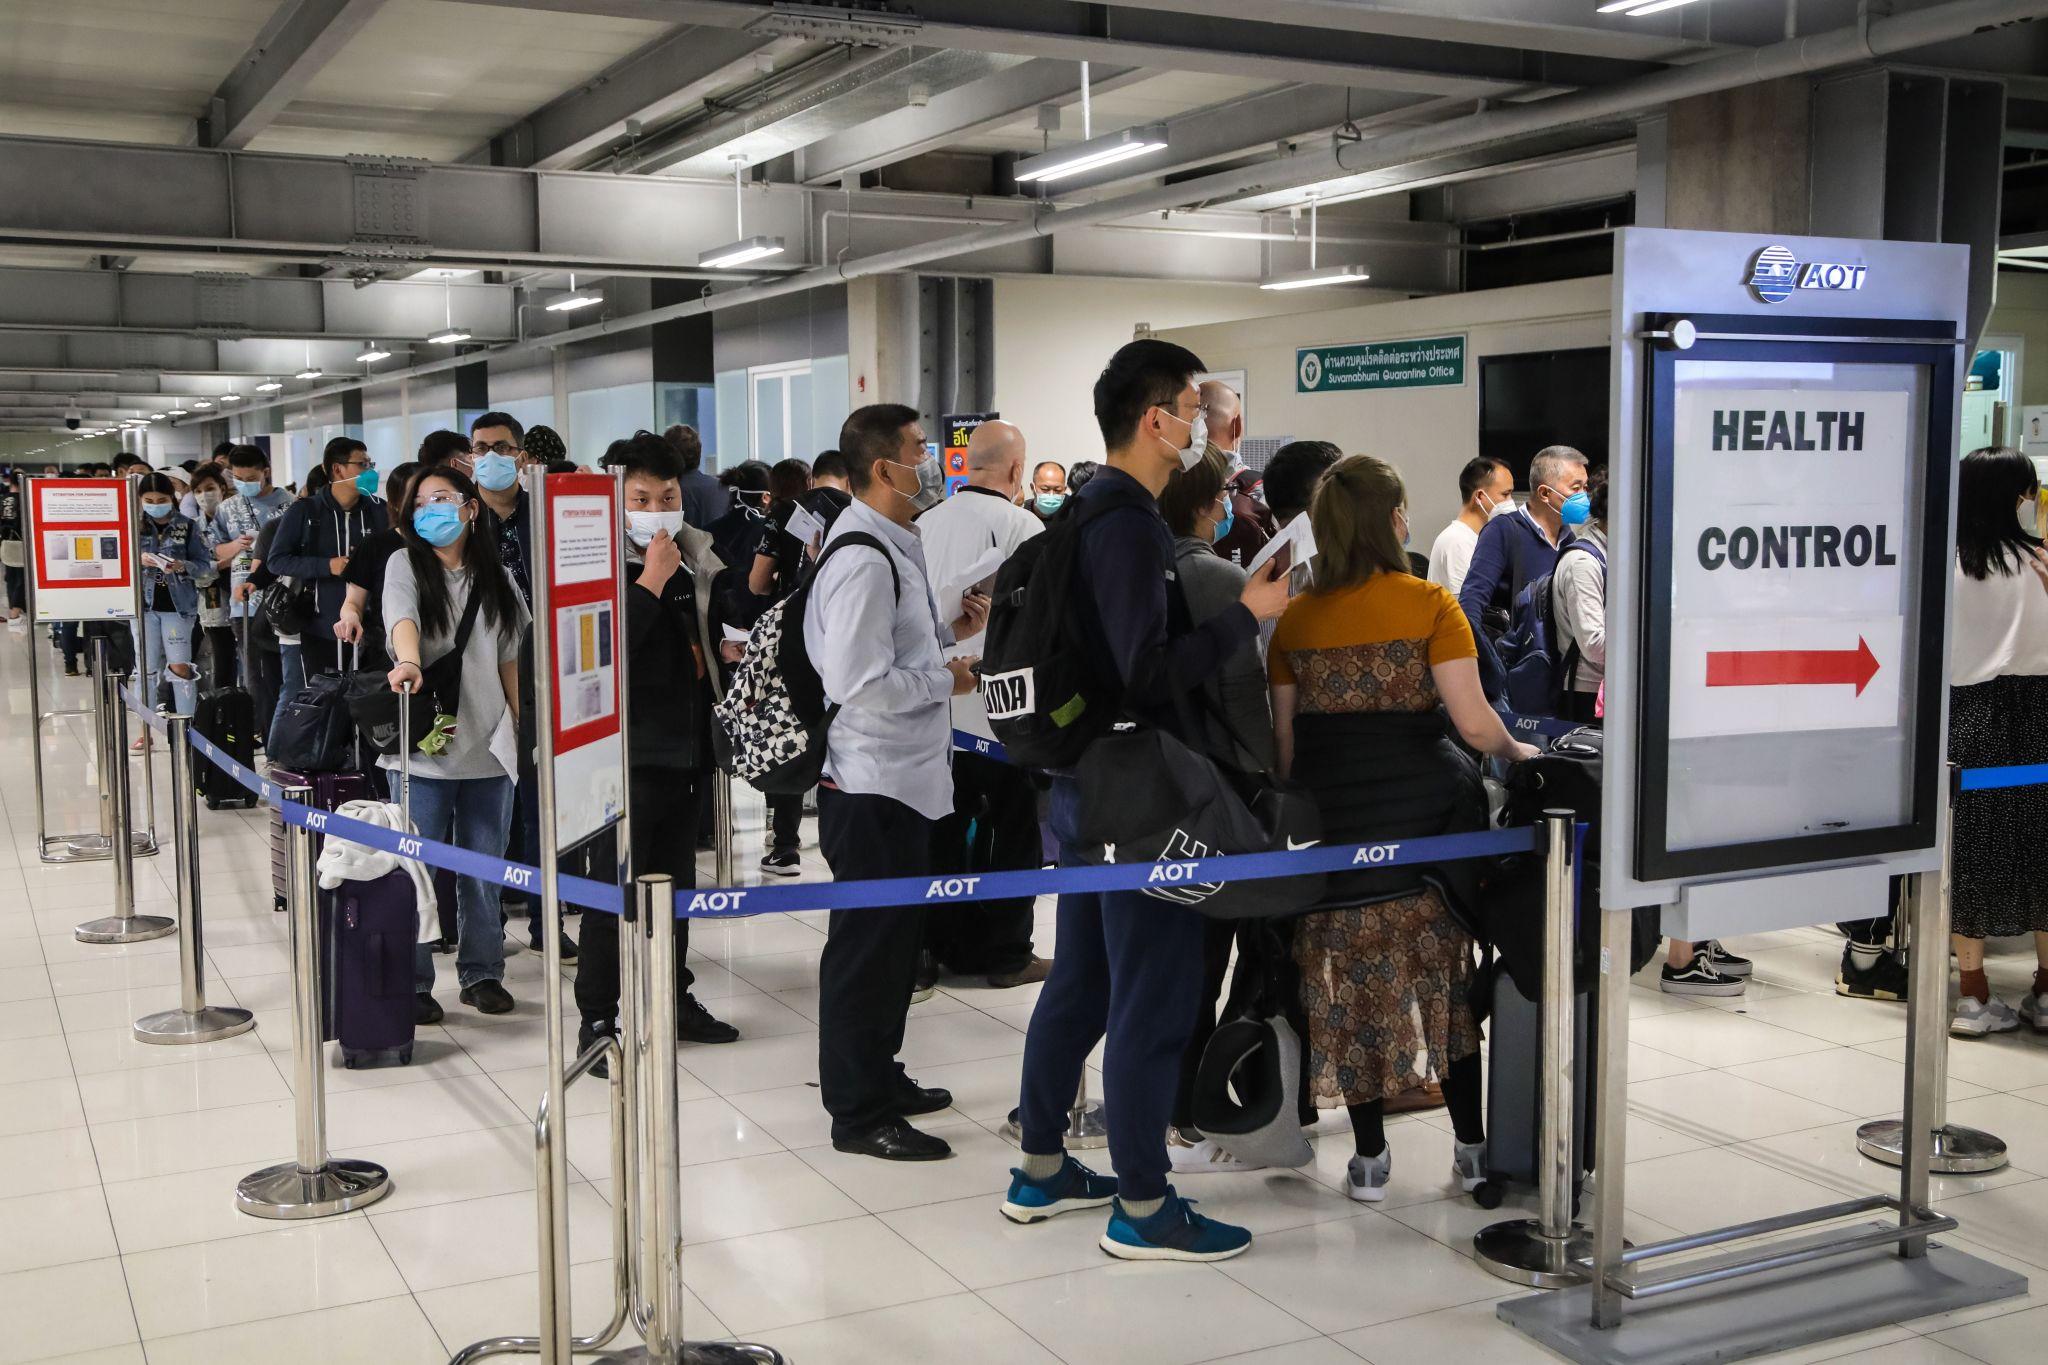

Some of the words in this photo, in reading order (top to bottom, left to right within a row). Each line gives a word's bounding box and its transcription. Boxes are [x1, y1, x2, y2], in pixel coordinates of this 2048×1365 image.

[1803, 263, 1868, 289] AOT
[1324, 345, 1460, 370] ด่านควบคุมโรคติดต่อระหว่างประเทศ
[1383, 366, 1427, 381] Quarantine
[1429, 365, 1455, 377] Office
[1712, 410, 1865, 451] HEALTH
[1697, 524, 1897, 571] CONTROL
[1515, 717, 1540, 731] AOT
[975, 739, 990, 754] AOT
[261, 781, 270, 797] AOT
[306, 811, 327, 829] AOT
[398, 837, 422, 857] AOT
[1352, 844, 1400, 865] AOT
[503, 865, 532, 887] AOT
[1148, 862, 1199, 883] AOT
[925, 877, 981, 899] AOT
[688, 891, 747, 912] AOT
